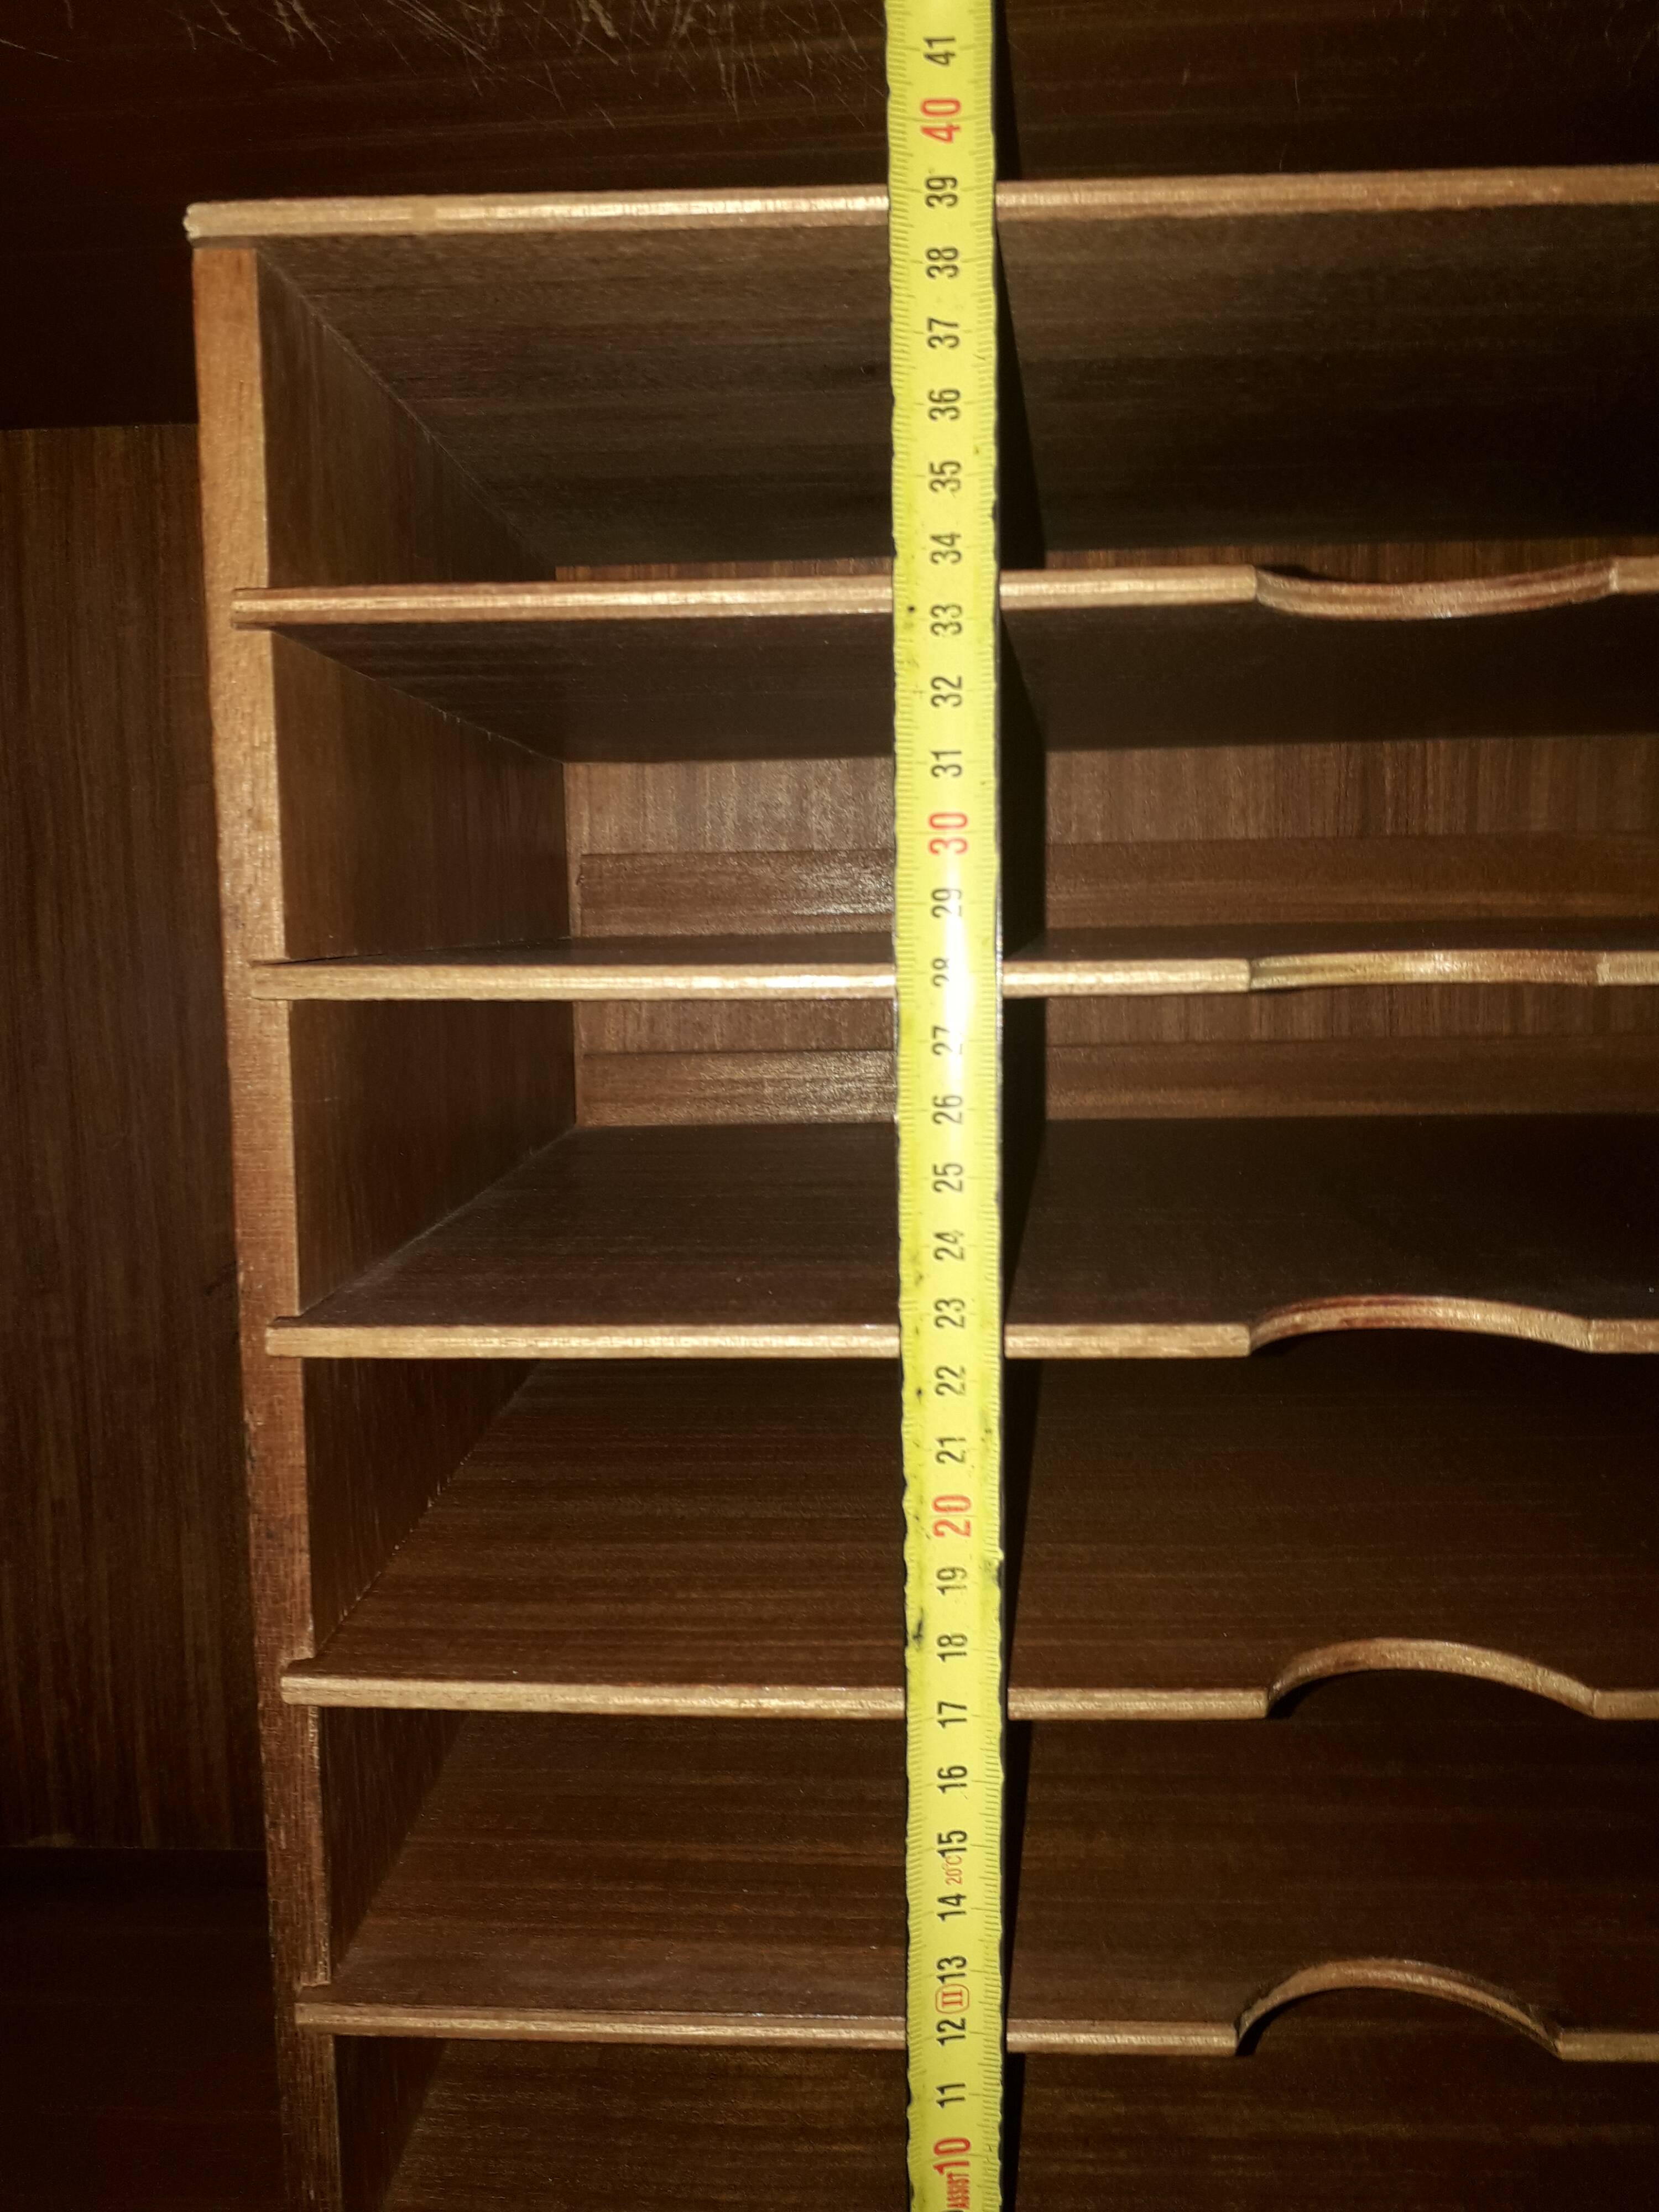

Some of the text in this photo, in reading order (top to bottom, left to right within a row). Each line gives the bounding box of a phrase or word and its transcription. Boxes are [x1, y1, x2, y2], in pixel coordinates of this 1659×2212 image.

[924, 36, 956, 66] 41
[920, 98, 962, 143] 40
[925, 176, 959, 208] 39
[925, 247, 960, 279] 38
[926, 317, 960, 349] 37
[927, 388, 961, 421] 36
[928, 460, 962, 493] 35
[930, 533, 962, 565] 34
[930, 604, 963, 637] 33
[930, 676, 963, 708] 32
[930, 750, 963, 778] 31
[928, 812, 968, 855] 30
[931, 888, 962, 919] 29
[932, 1025, 963, 1056] 27
[932, 1095, 962, 1125] 26
[932, 1163, 963, 1193] 25
[933, 1232, 964, 1261] 24
[933, 1298, 966, 1328] 23
[934, 1365, 966, 1396] 22
[935, 1437, 966, 1464] 21
[932, 1495, 972, 1537] 20
[936, 1567, 967, 1595] 19
[936, 1633, 968, 1662] 18
[937, 1700, 968, 1729] 17
[936, 1765, 968, 1794] 16
[936, 1829, 968, 1859] 15
[936, 1893, 967, 1922] 14
[936, 1955, 967, 1985] 13
[936, 2017, 967, 2047] 12
[936, 2083, 966, 2109] 11
[932, 2137, 972, 2175] 10
